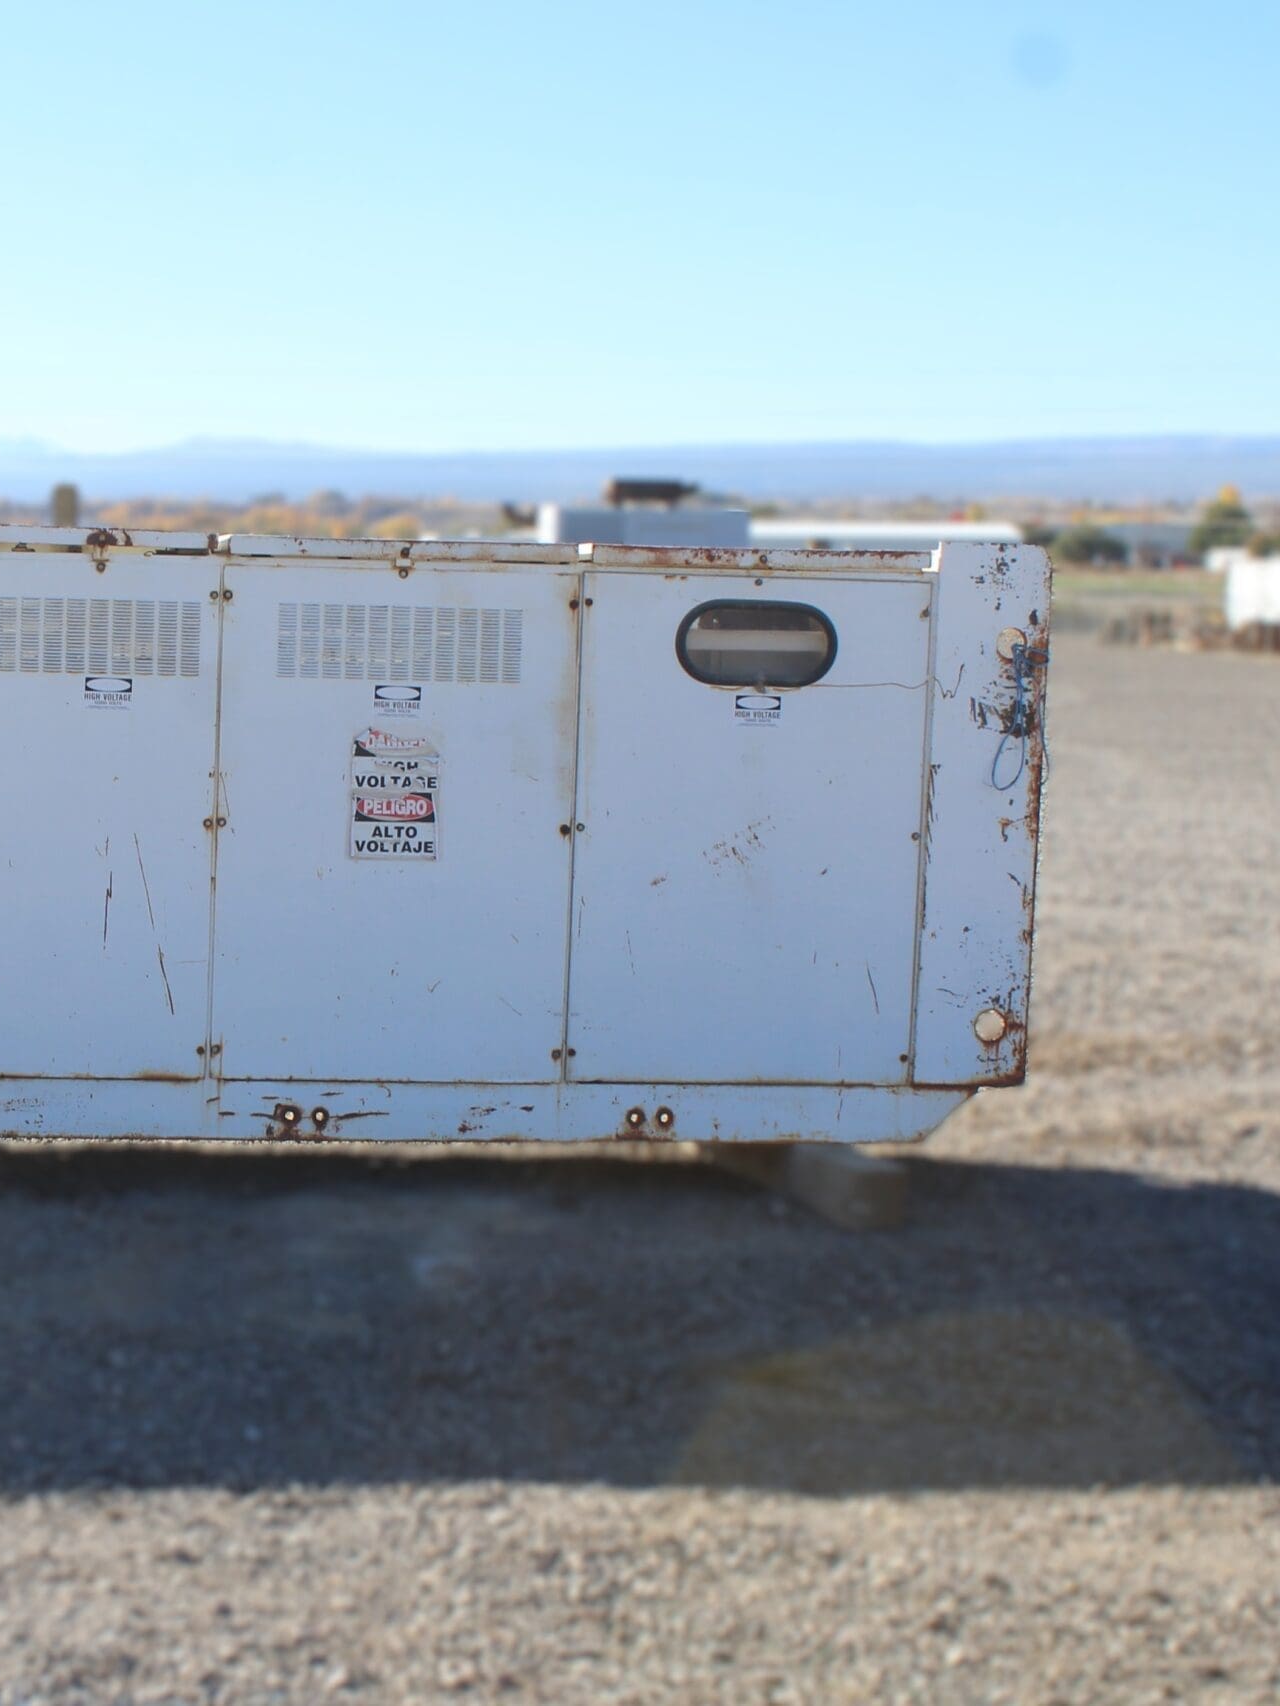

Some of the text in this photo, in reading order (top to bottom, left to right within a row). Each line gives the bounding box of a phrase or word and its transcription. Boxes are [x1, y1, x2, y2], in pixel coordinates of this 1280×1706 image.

[84, 692, 132, 702] HIGH VOLTAGE
[392, 701, 420, 710] VOLTAGE
[735, 710, 781, 719] HIGH VOLTAGE
[363, 799, 427, 816] PELIGRO
[371, 826, 418, 839] ALTO
[355, 840, 434, 854] VOLTAJE
